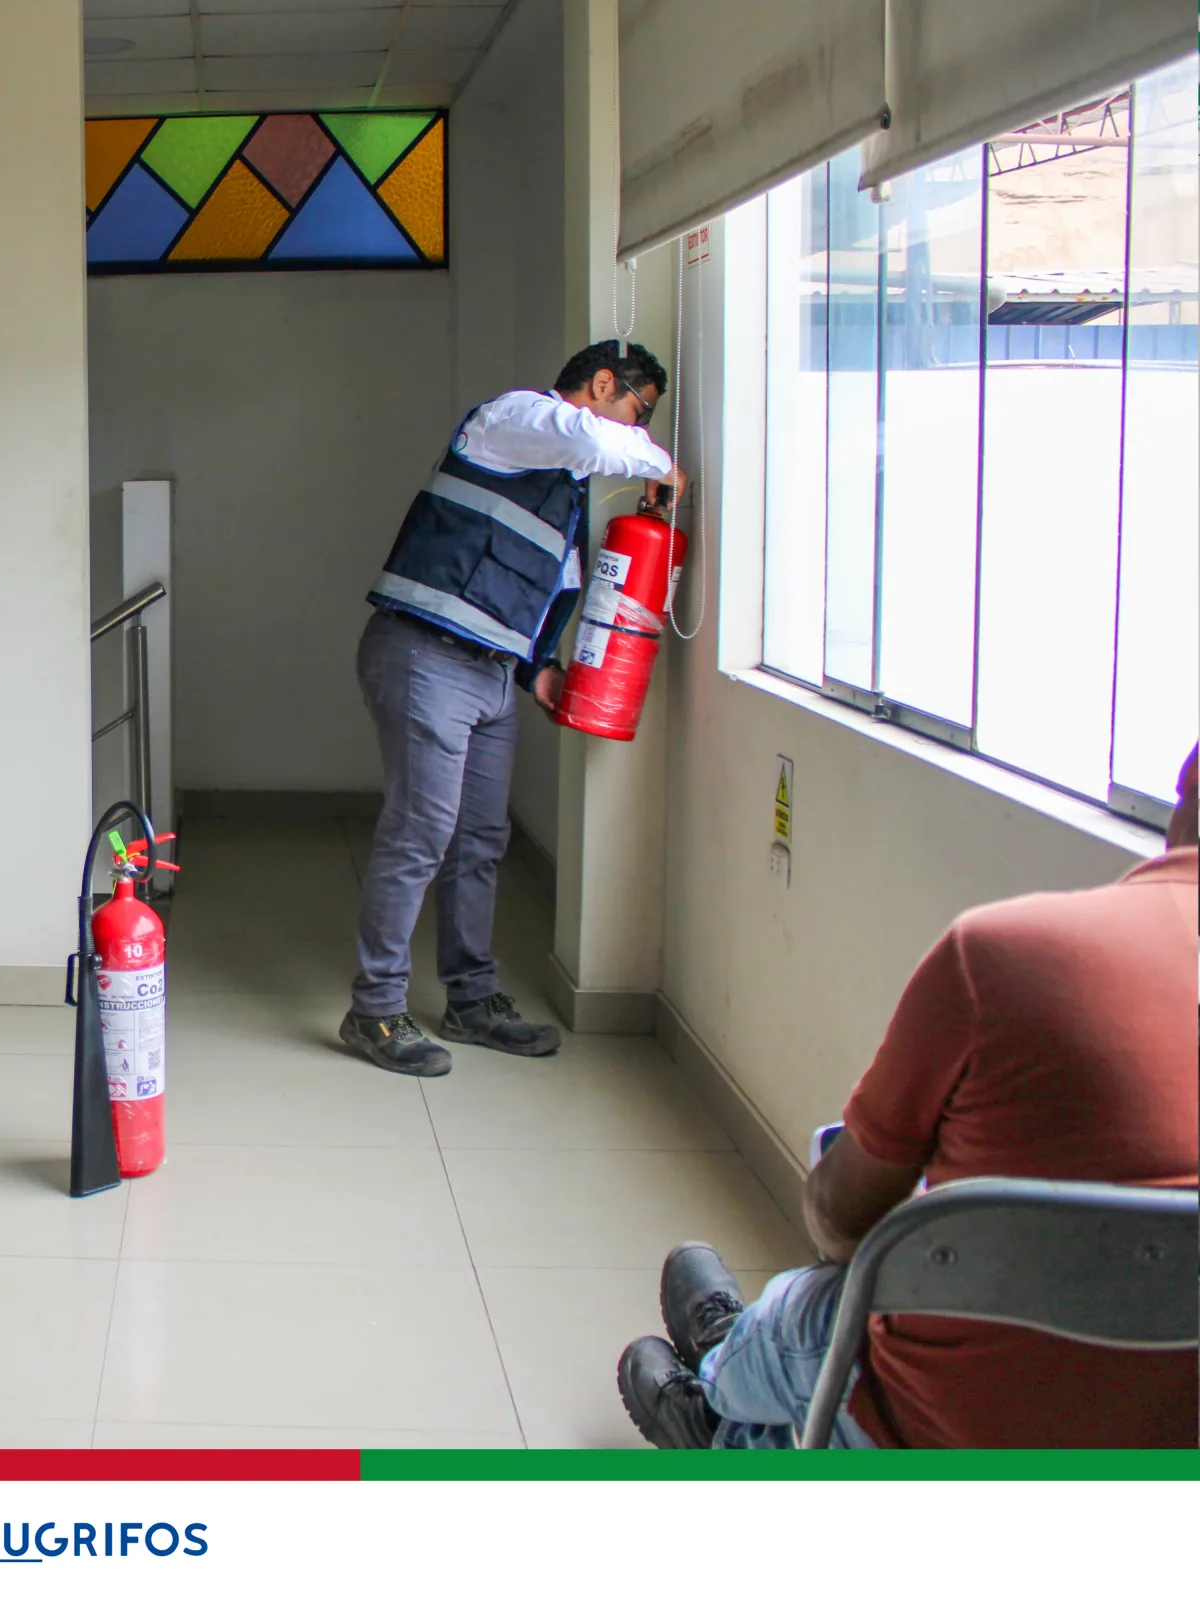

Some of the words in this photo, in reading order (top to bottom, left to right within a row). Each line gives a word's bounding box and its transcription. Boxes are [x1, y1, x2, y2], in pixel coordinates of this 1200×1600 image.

[688, 228, 708, 249] EXTITOR
[596, 560, 619, 577] PQS
[124, 945, 143, 958] 10
[99, 997, 165, 1010] NSTRUCCIONES
